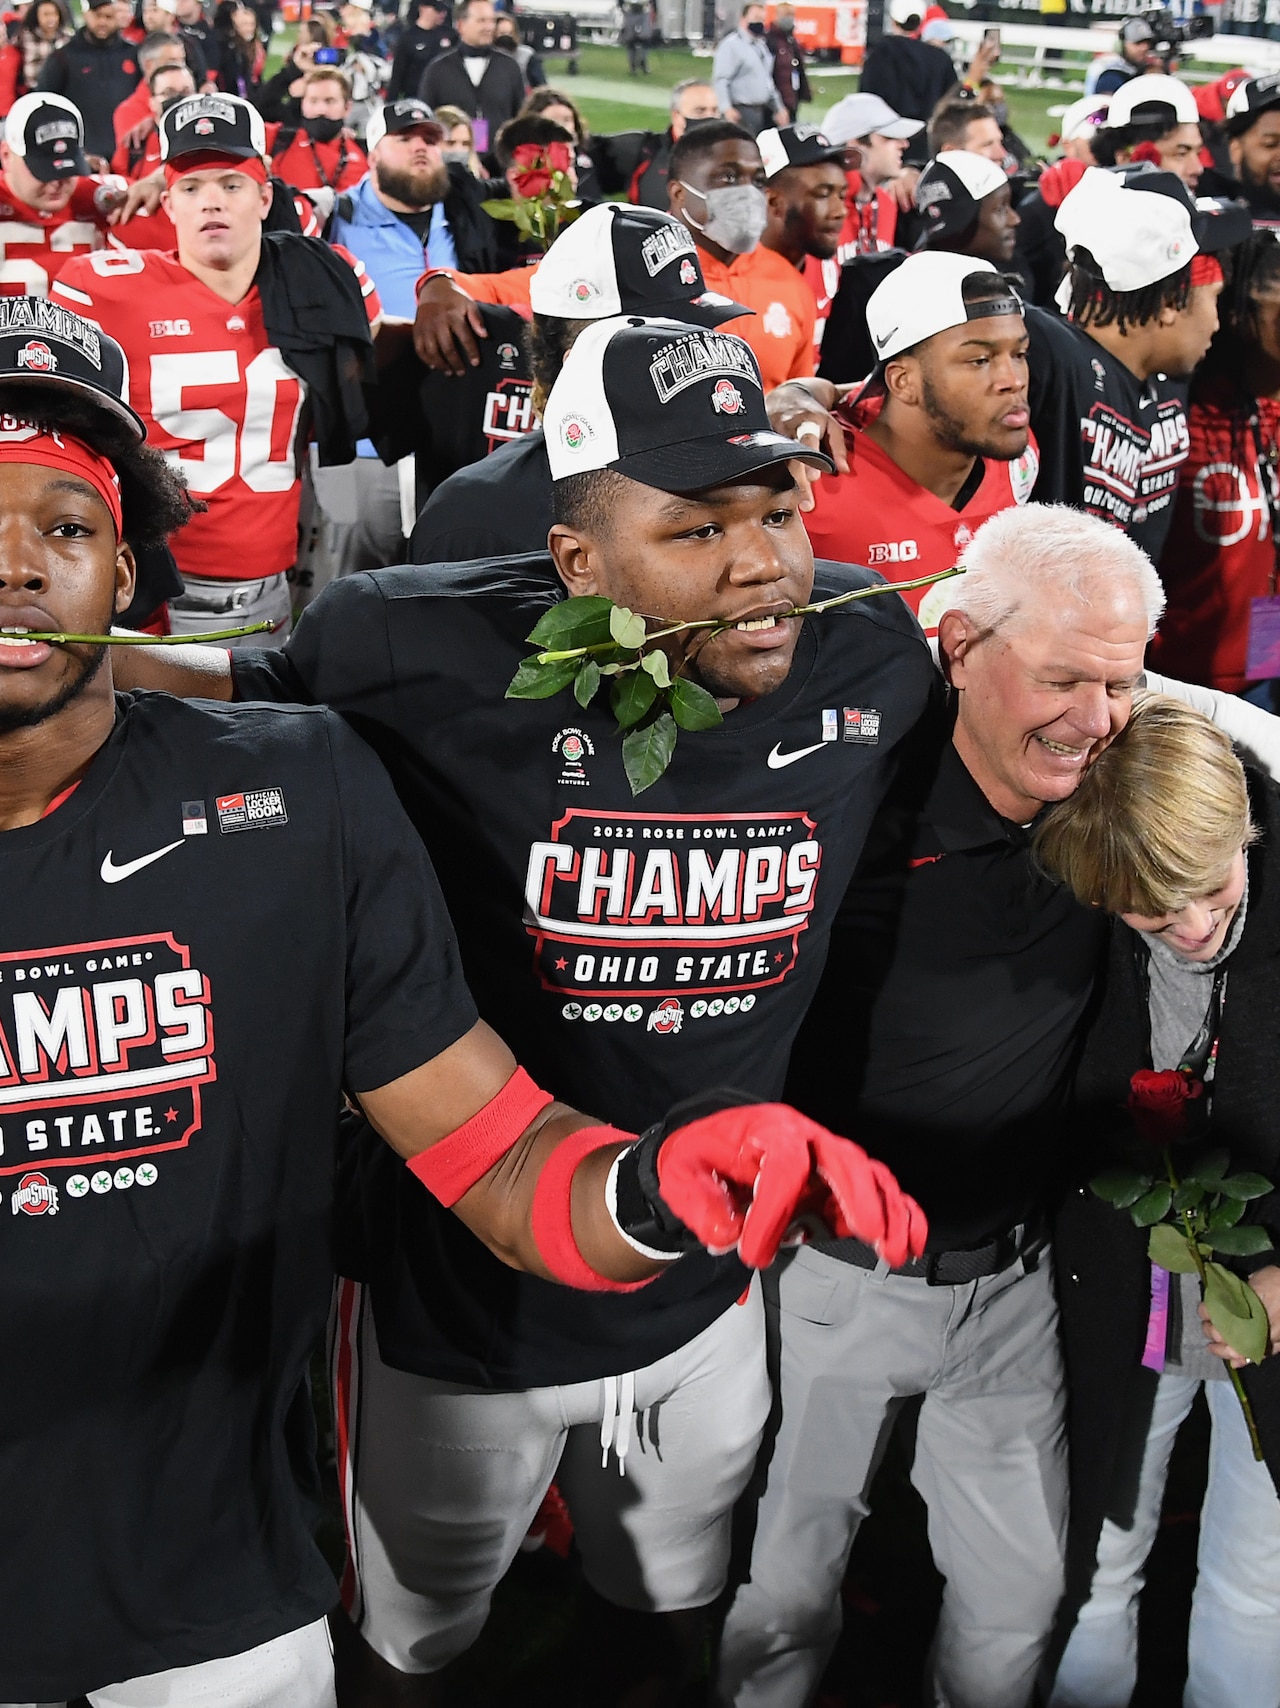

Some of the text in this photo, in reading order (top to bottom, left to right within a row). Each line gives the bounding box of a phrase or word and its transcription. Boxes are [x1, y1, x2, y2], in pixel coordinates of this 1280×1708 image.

[649, 336, 762, 404] CHAMPS
[149, 348, 308, 493] 50
[245, 790, 280, 801] OFFICIAL
[246, 797, 281, 809] LOCKER
[247, 805, 284, 820] ROOM
[593, 826, 635, 838] 2022
[642, 827, 685, 839] ROSE
[692, 828, 738, 839] BOWL
[523, 840, 822, 939] CHAMPS
[15, 962, 75, 981] BOWL
[86, 953, 143, 972] GAME
[574, 954, 659, 982] OHIO
